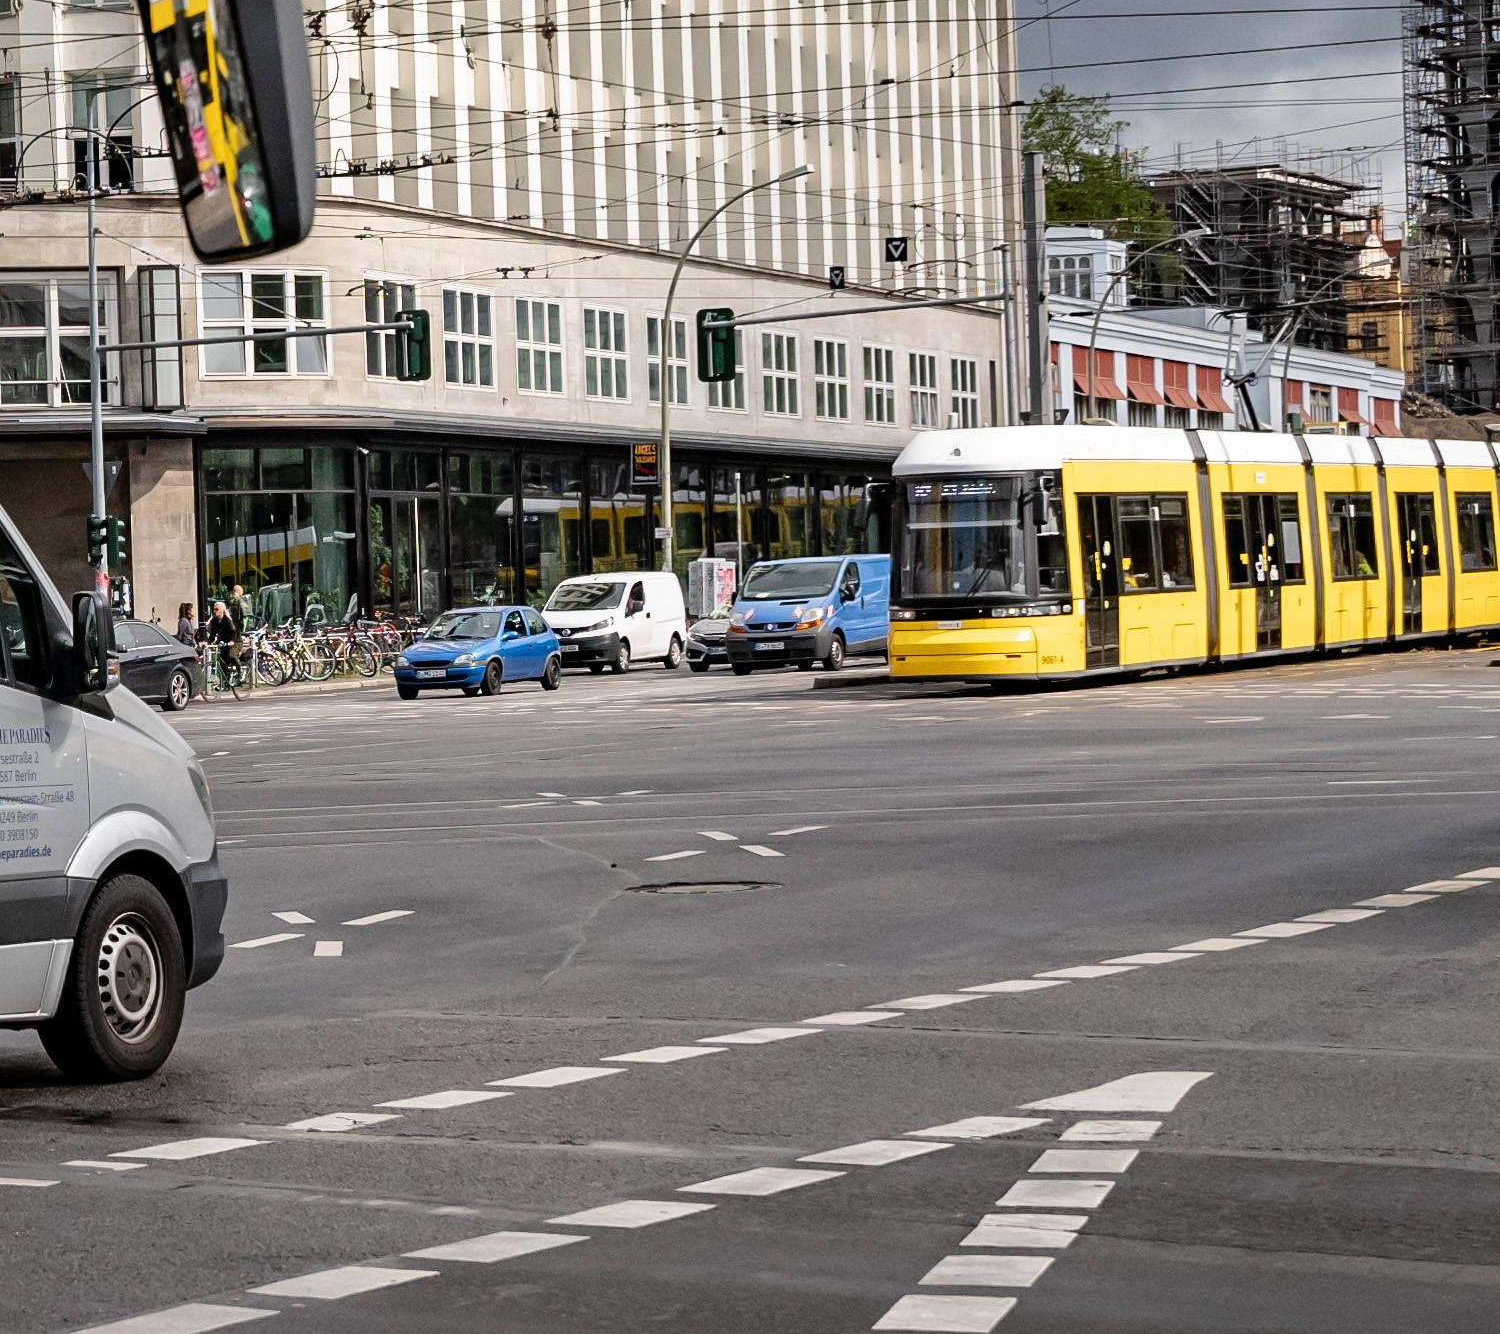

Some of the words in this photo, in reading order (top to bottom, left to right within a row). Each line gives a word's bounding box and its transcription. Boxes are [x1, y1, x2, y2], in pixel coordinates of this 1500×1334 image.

[34, 751, 39, 763] 2
[15, 770, 37, 782] Berlin
[65, 790, 75, 803] 48
[17, 810, 38, 823] Berlin
